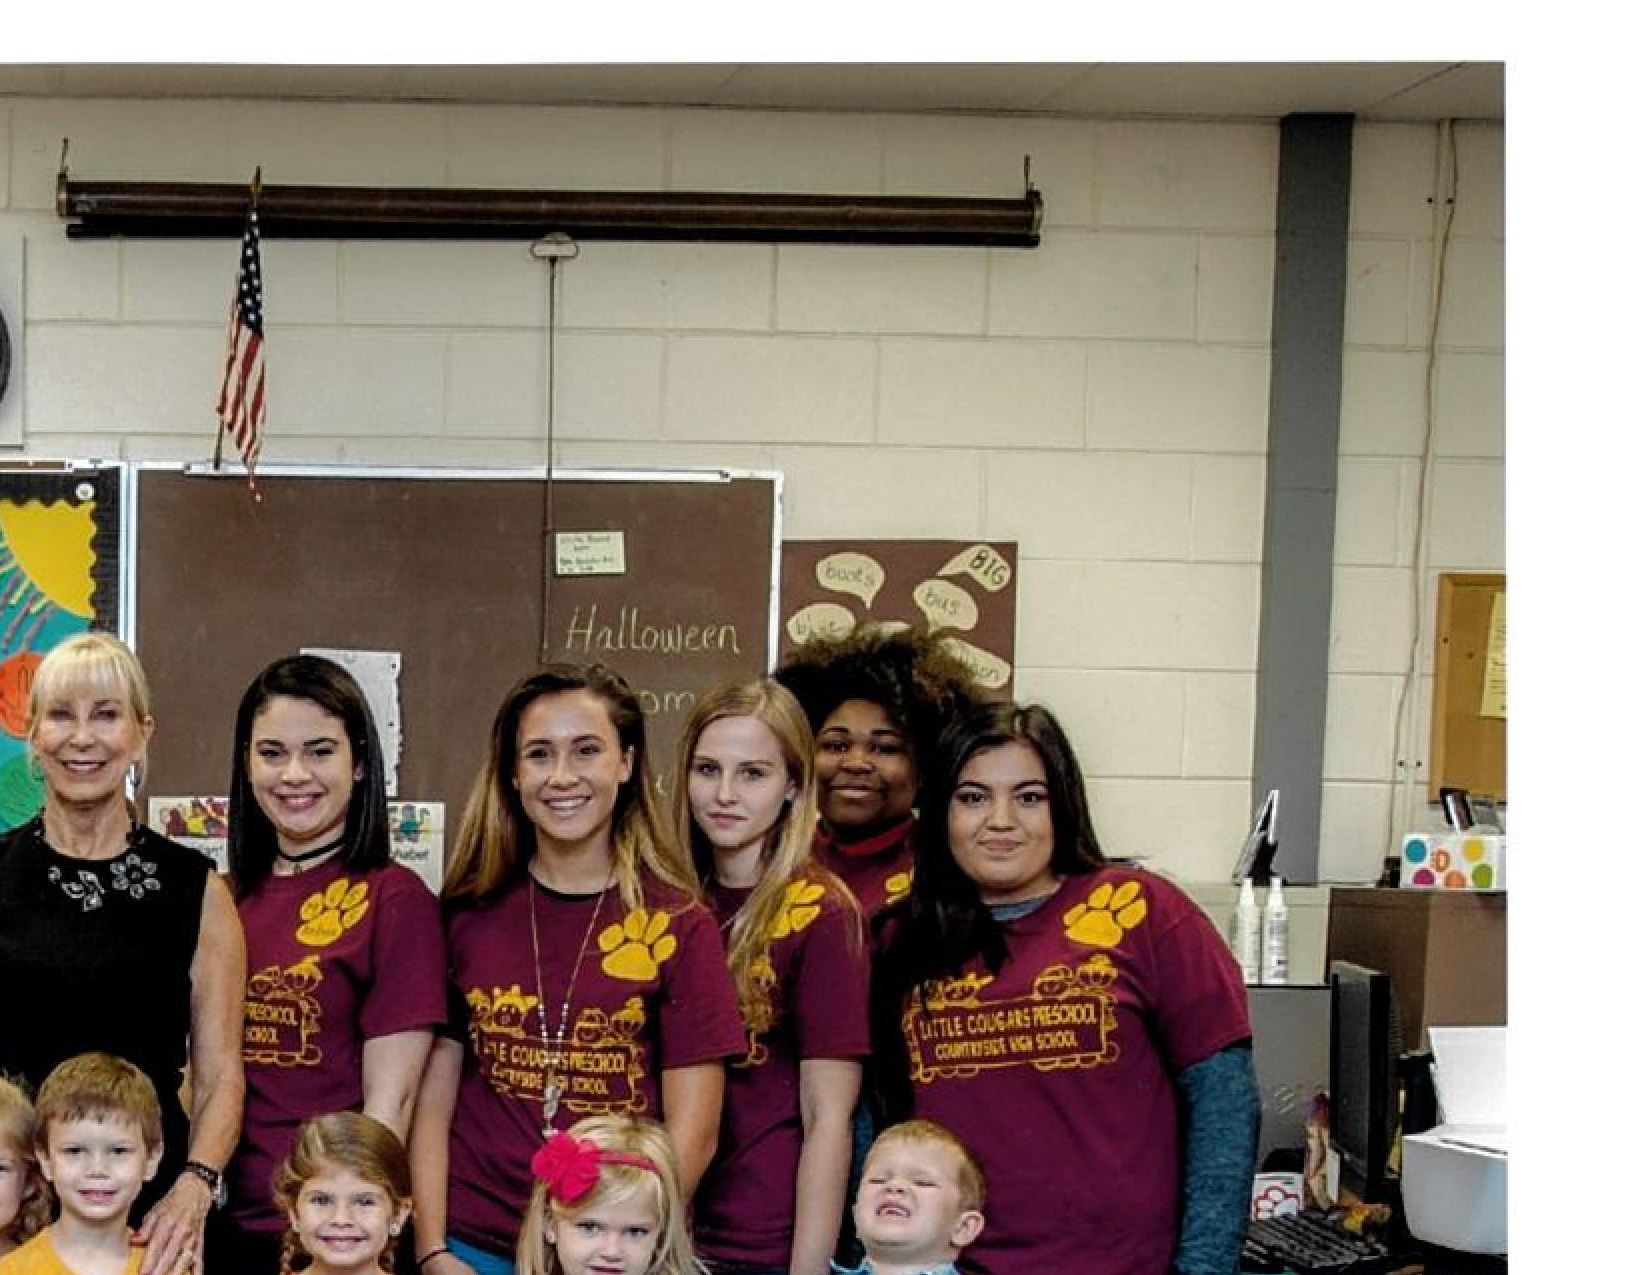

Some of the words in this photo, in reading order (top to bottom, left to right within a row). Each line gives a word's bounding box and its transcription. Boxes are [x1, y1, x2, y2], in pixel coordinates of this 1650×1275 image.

[969, 548, 1008, 585] BIG
[924, 588, 960, 615] bus
[564, 603, 741, 654] Halloween
[919, 1014, 966, 1041] LITTLE
[967, 1008, 1032, 1036] COUGARS
[1032, 1003, 1098, 1027] PRESCHOOL
